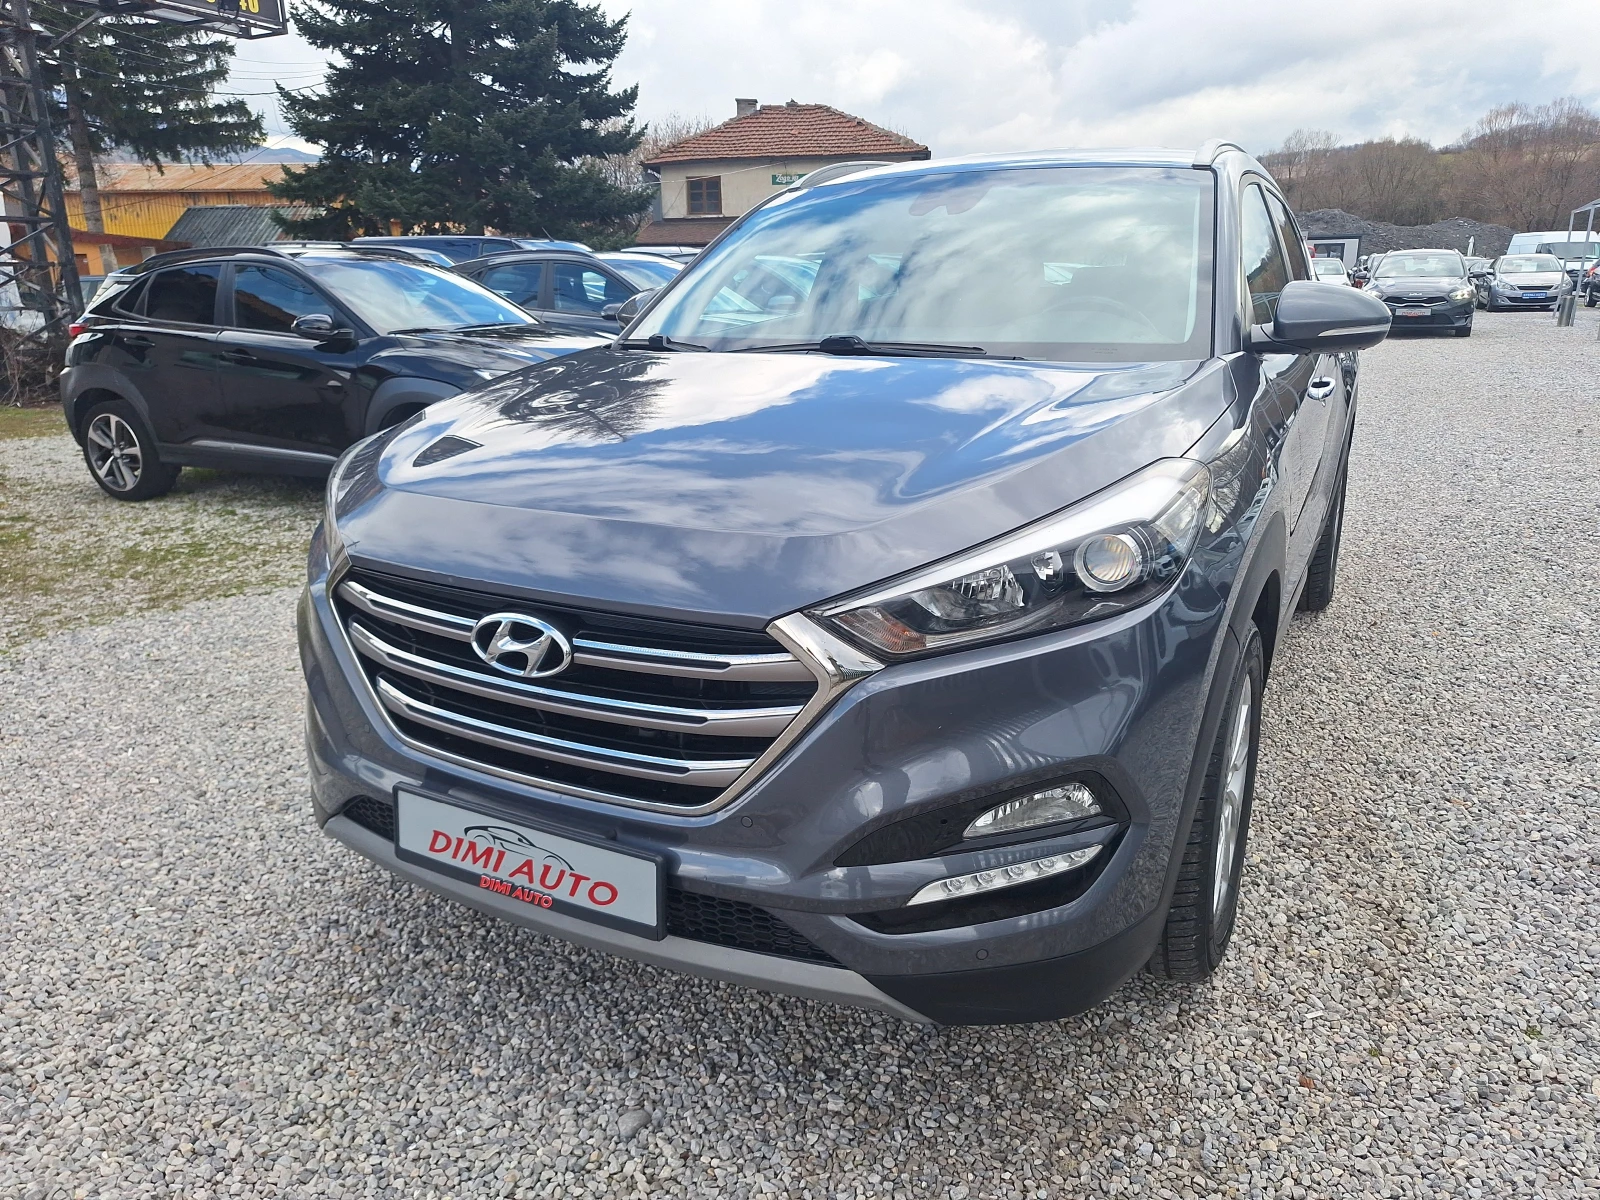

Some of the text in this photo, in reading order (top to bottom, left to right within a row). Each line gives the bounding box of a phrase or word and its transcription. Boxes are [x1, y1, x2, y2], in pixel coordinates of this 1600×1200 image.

[428, 830, 619, 906] DIMI AUTO
[479, 875, 554, 909] DIMI AUTO
